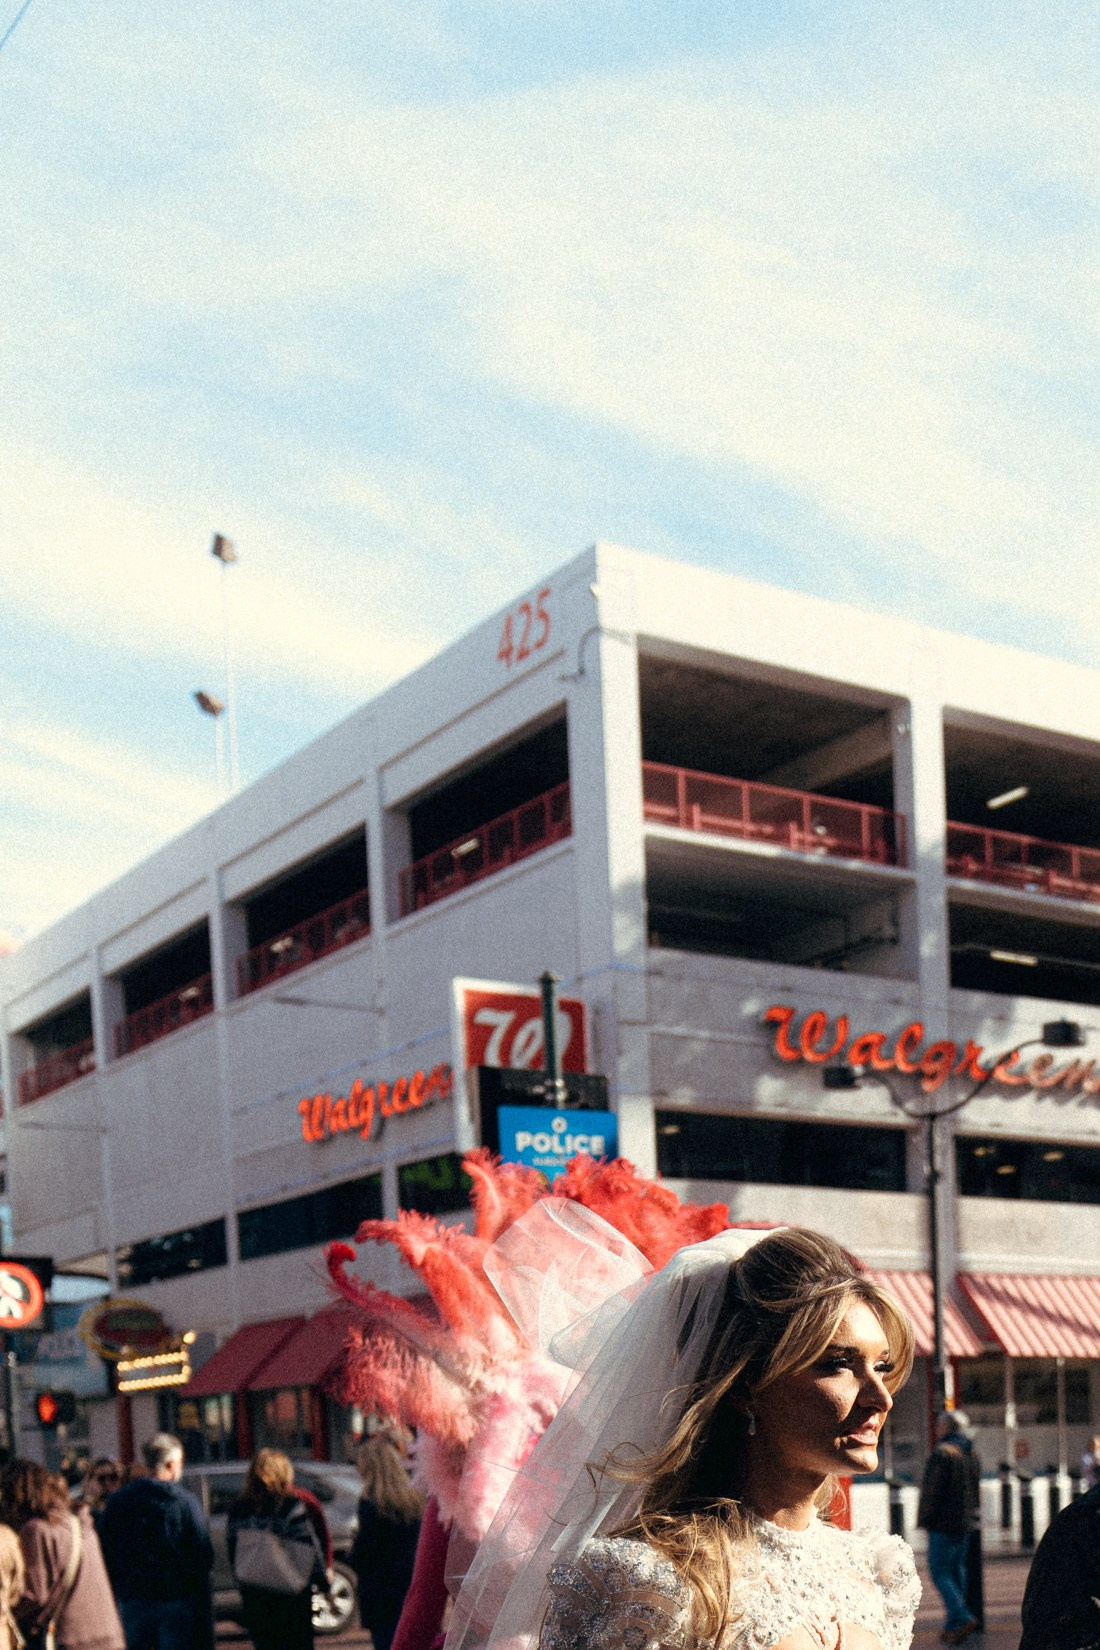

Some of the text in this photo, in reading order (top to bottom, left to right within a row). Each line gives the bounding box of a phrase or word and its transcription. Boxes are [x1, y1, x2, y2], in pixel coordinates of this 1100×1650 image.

[497, 586, 552, 671] 425
[298, 1062, 455, 1143] Walgreen
[515, 1130, 605, 1156] POLICE
